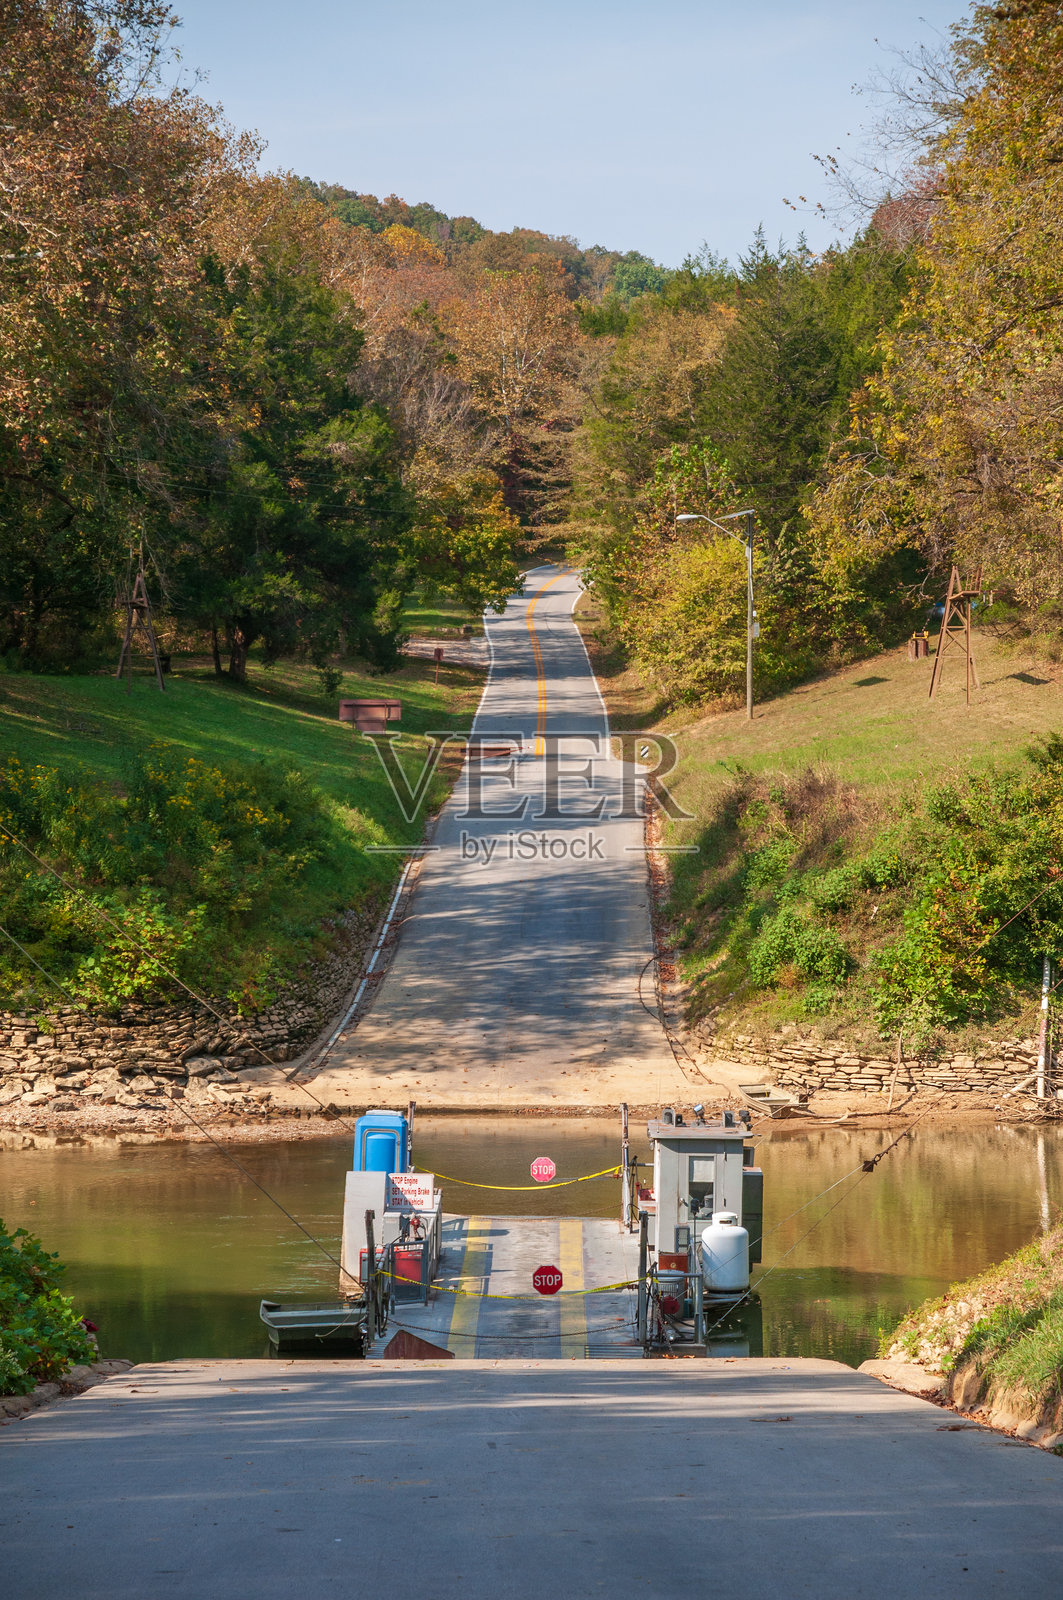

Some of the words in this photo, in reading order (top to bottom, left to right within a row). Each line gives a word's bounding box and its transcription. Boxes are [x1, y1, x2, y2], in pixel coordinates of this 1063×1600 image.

[532, 1165, 554, 1175] STOP
[392, 1176, 403, 1184] STOP
[404, 1176, 418, 1186] Engine
[392, 1187, 400, 1195] SET
[401, 1187, 417, 1197] Parking
[418, 1187, 430, 1195] Brake
[392, 1197, 403, 1205] STAY
[534, 1274, 561, 1286] STOP
